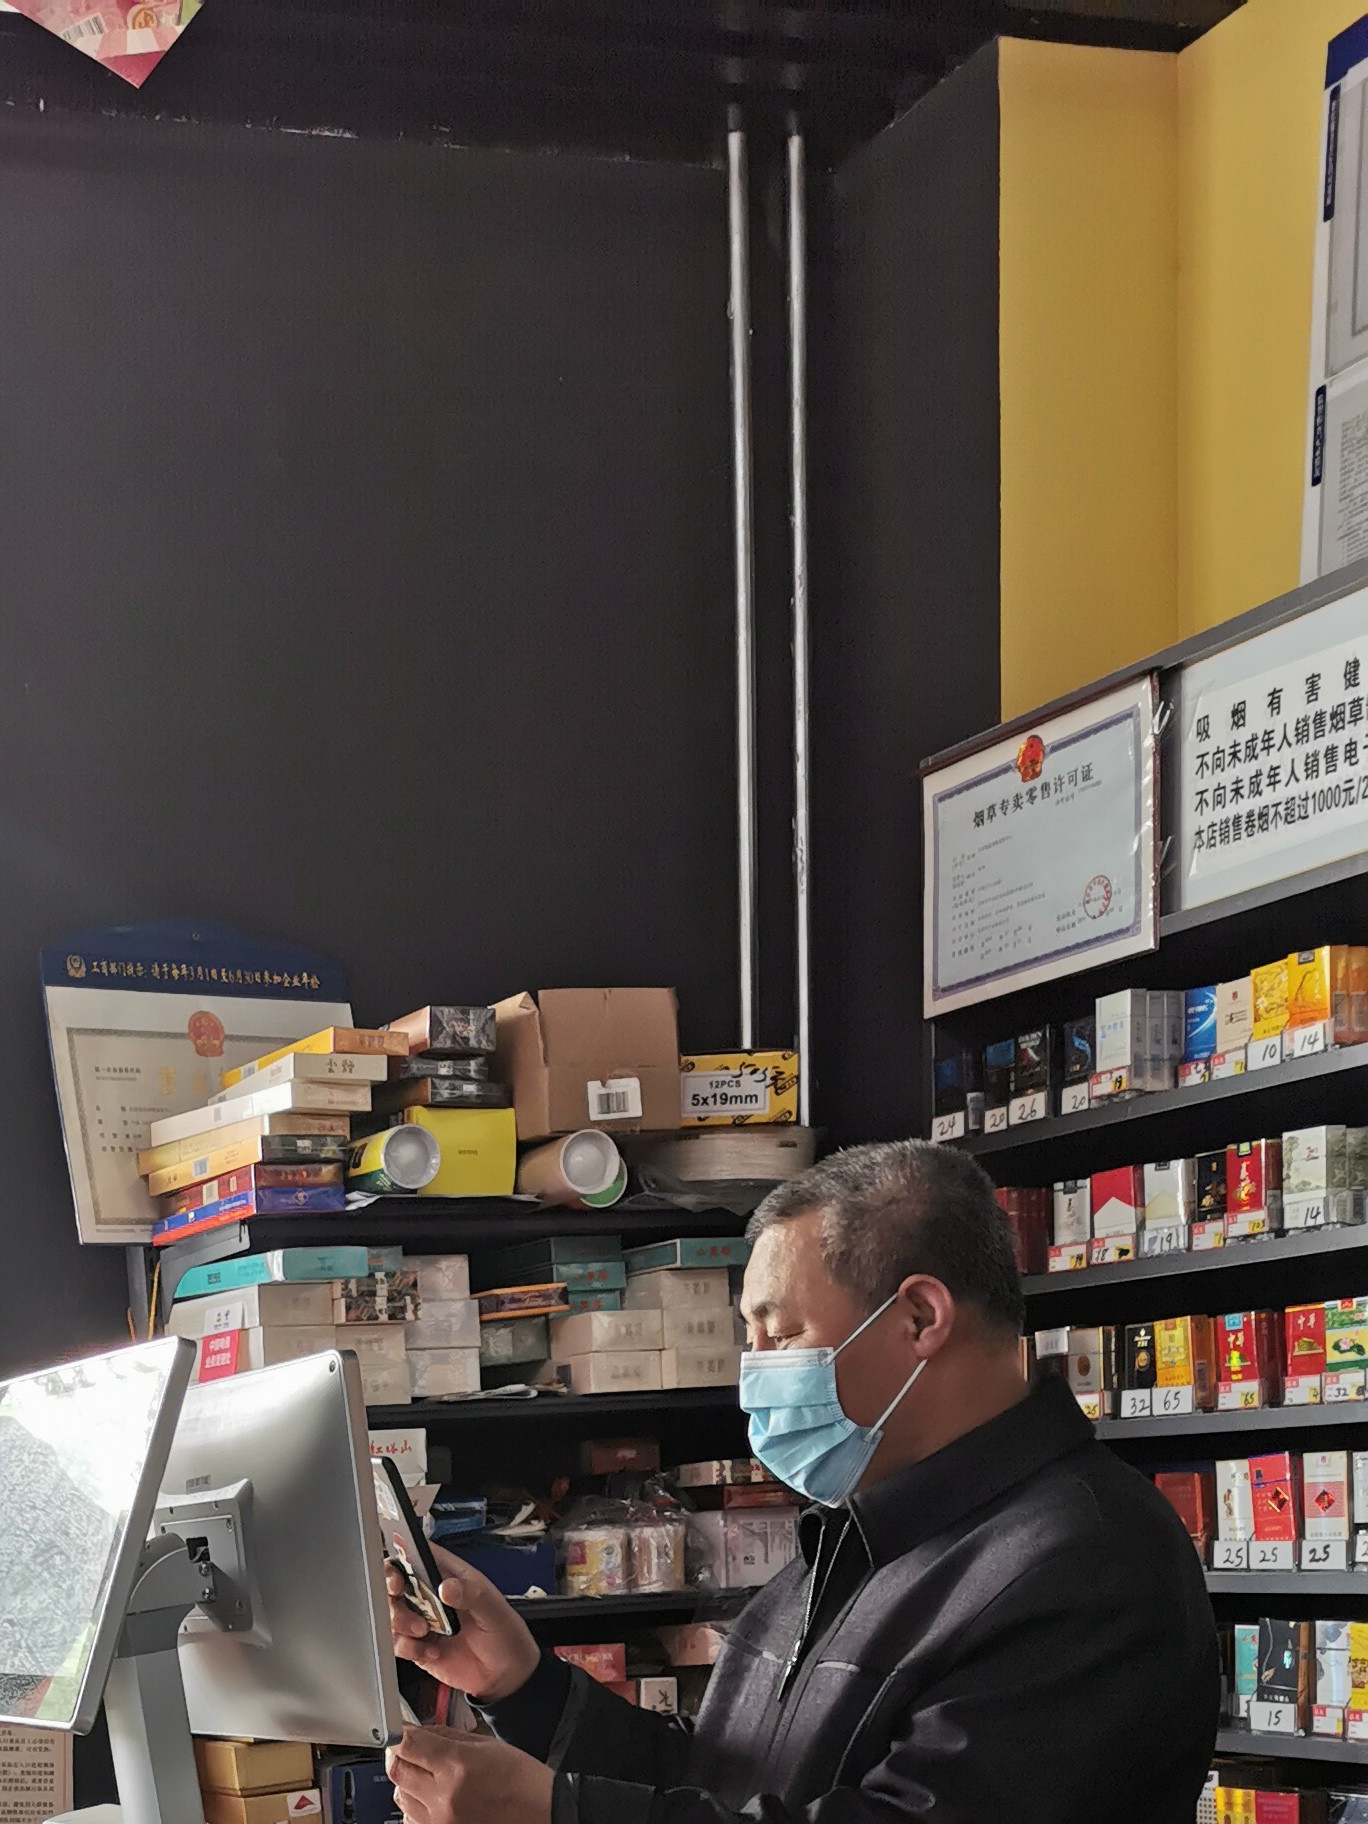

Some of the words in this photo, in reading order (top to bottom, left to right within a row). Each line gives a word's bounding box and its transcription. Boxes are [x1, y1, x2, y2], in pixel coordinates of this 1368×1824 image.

[1195, 696, 1368, 779] 不向未成年人销售烟草
[973, 762, 1094, 829] 烟草专卖零售许可证
[1300, 1031, 1319, 1049] 14
[709, 1080, 741, 1089] 12PCS
[691, 1092, 759, 1107] 5x19mm
[1304, 1205, 1322, 1222] 14
[1130, 1397, 1150, 1413] 32
[1163, 1390, 1181, 1411] 65
[1222, 1547, 1244, 1566] 25
[1259, 1546, 1278, 1563] 25
[1308, 1544, 1331, 1563] 25
[1267, 1708, 1283, 1728] 15
